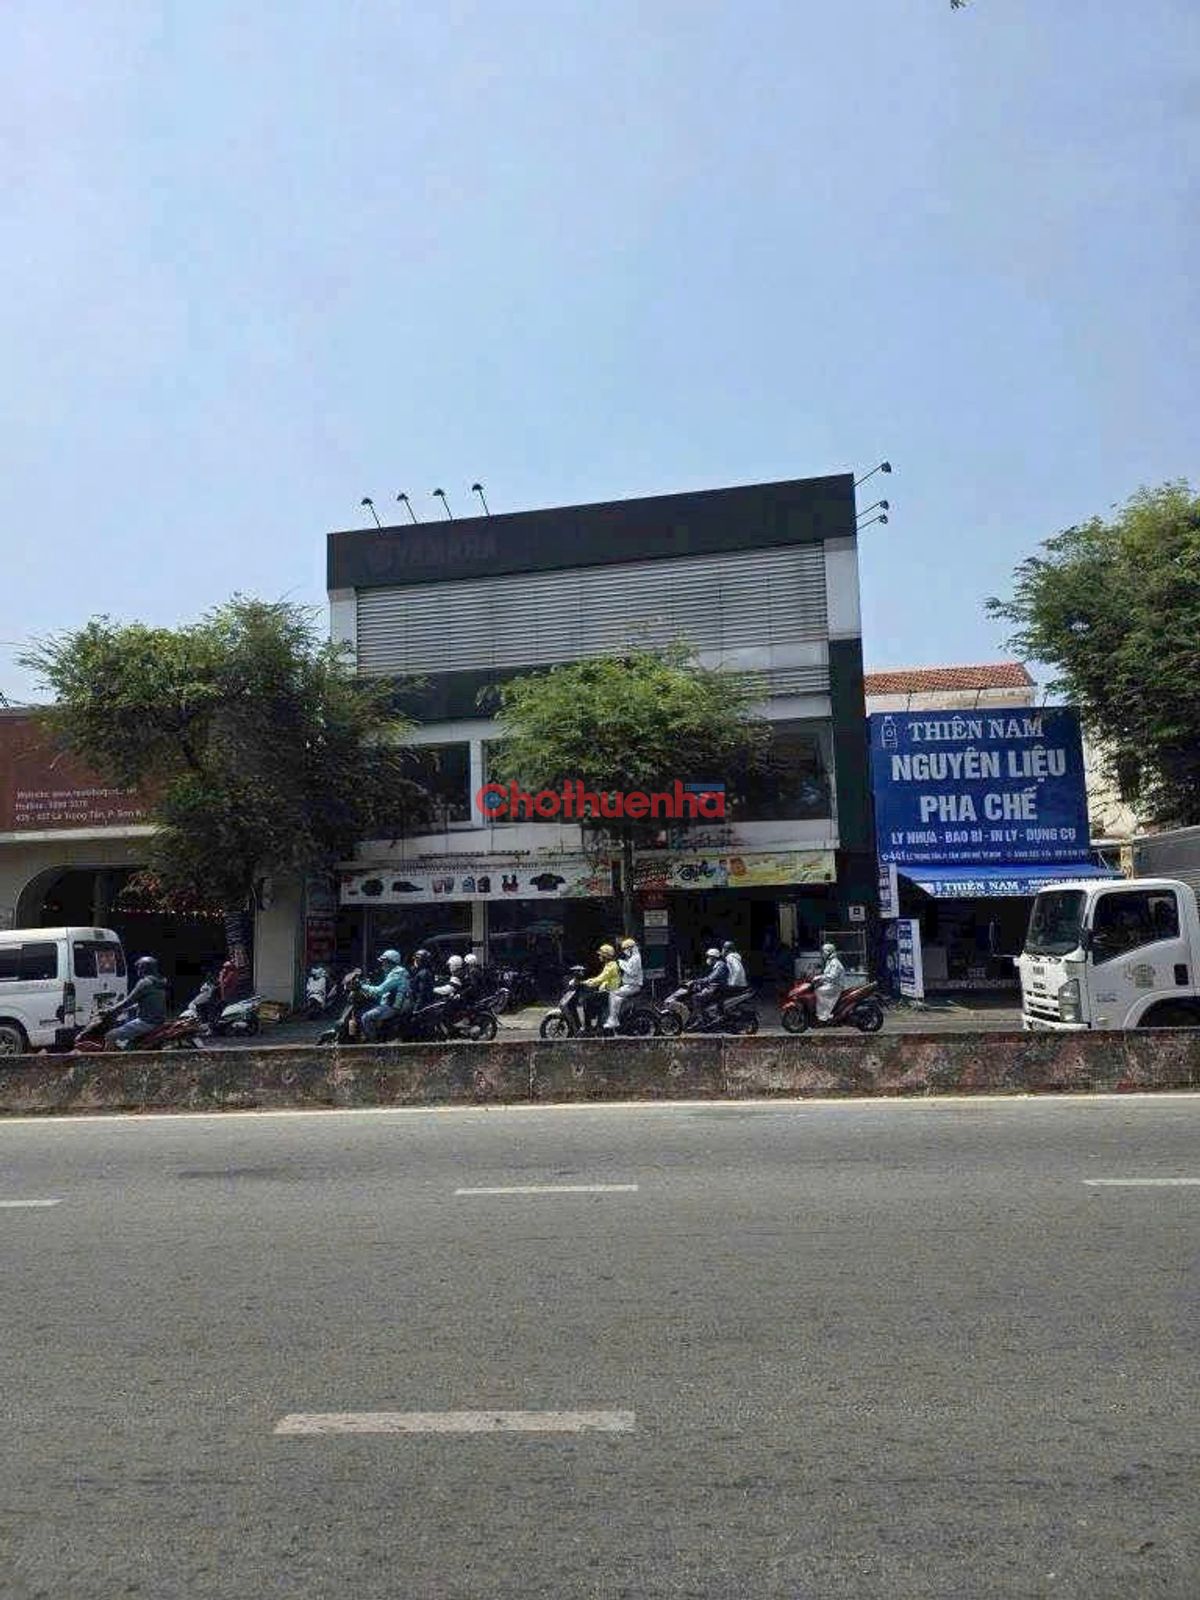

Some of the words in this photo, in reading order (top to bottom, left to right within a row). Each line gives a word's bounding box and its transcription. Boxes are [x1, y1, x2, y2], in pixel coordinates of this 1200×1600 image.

[908, 716, 982, 741] THIÊN
[989, 718, 1045, 739] NAM
[891, 747, 1000, 781] NGUYÊN
[1007, 745, 1066, 782] LIỆU
[920, 794, 977, 823] PHA
[984, 785, 1038, 821] CHẾ
[989, 880, 1019, 891] NAM
